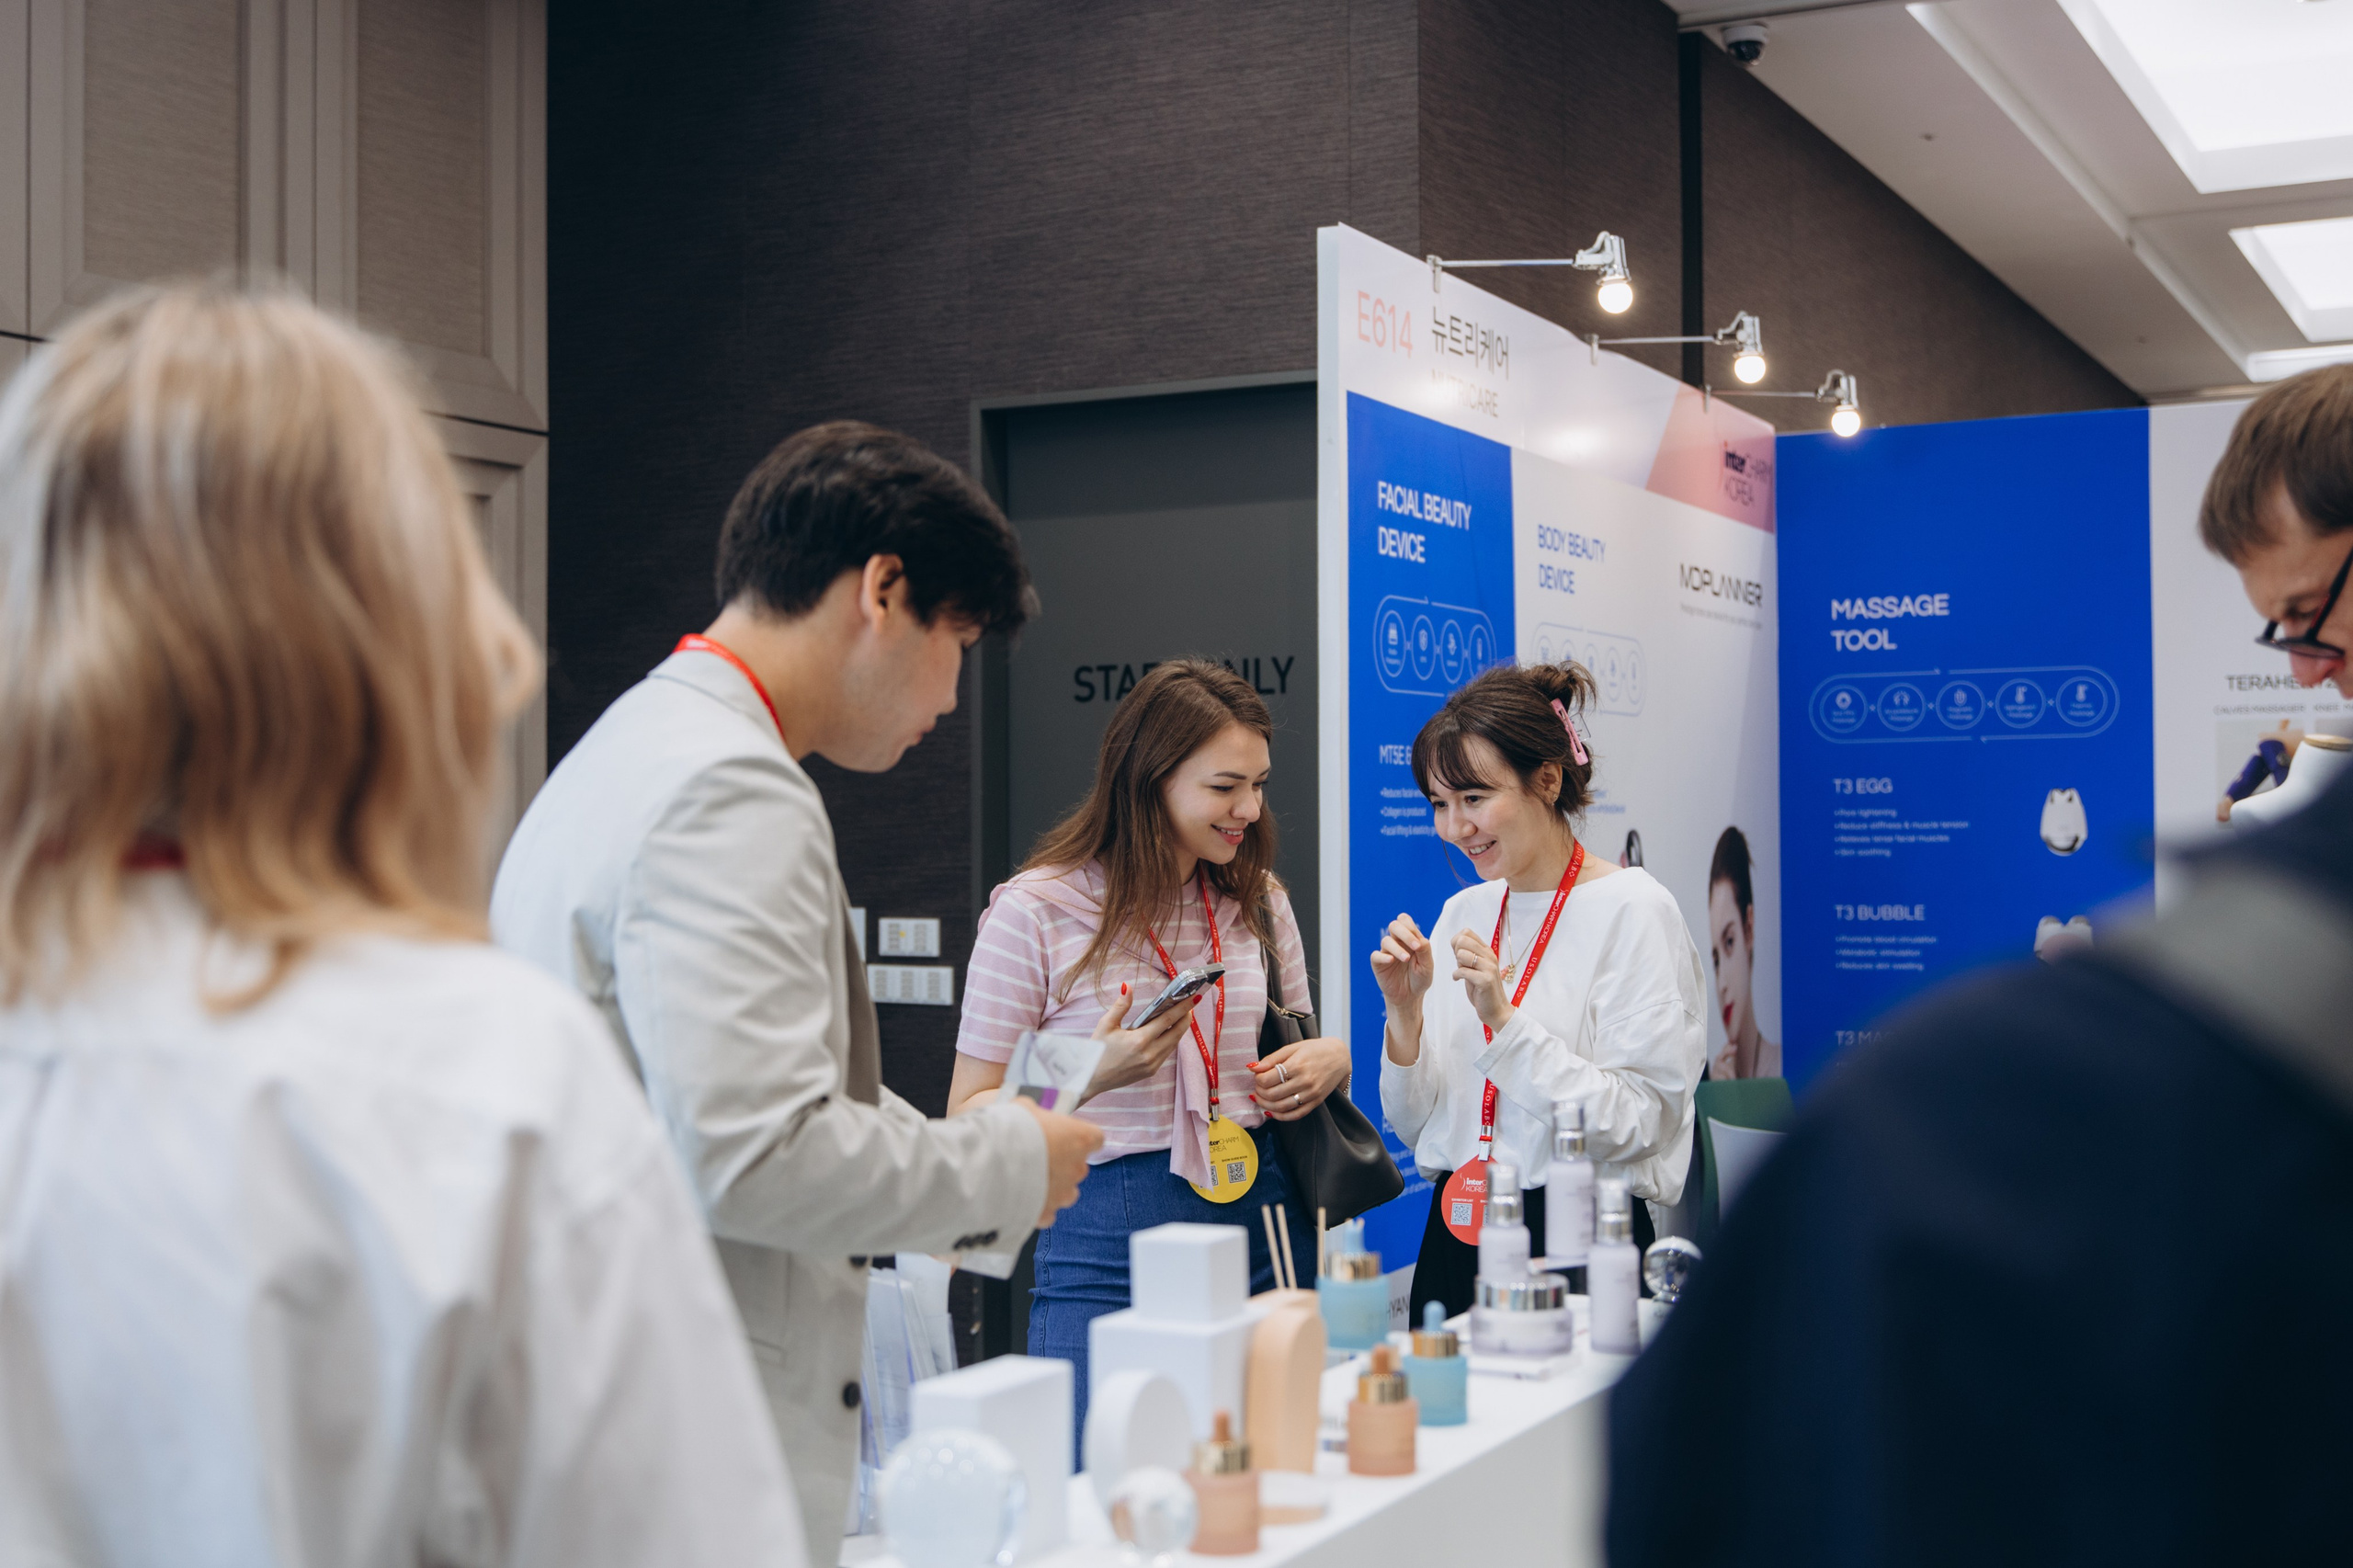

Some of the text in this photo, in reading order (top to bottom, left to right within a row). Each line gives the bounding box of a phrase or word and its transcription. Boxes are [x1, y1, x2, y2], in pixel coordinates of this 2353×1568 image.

[1358, 290, 1414, 358] E614
[1432, 305, 1509, 381] 뉴트리케어
[1378, 480, 1472, 531] FACIAL BEAUTY
[1378, 525, 1427, 563] DEVICE
[1538, 523, 1607, 562] BODY BEAUTY
[1539, 562, 1575, 595] DEVICE
[1830, 593, 1950, 620] MASSAGE
[1830, 628, 1898, 652] TOOL
[1074, 662, 1160, 703] STA
[2225, 673, 2337, 691] TERAHEZ
[1833, 777, 1893, 795] T3 EGG
[1835, 903, 1925, 921] T3 BUBBLE
[1518, 957, 1538, 995] USOLAB
[1483, 1083, 1495, 1121] USOLAB
[1209, 1135, 1240, 1147] terCHARM
[1209, 1144, 1227, 1153] OREA
[1466, 1177, 1488, 1187] interC
[1466, 1185, 1488, 1193] KOREA
